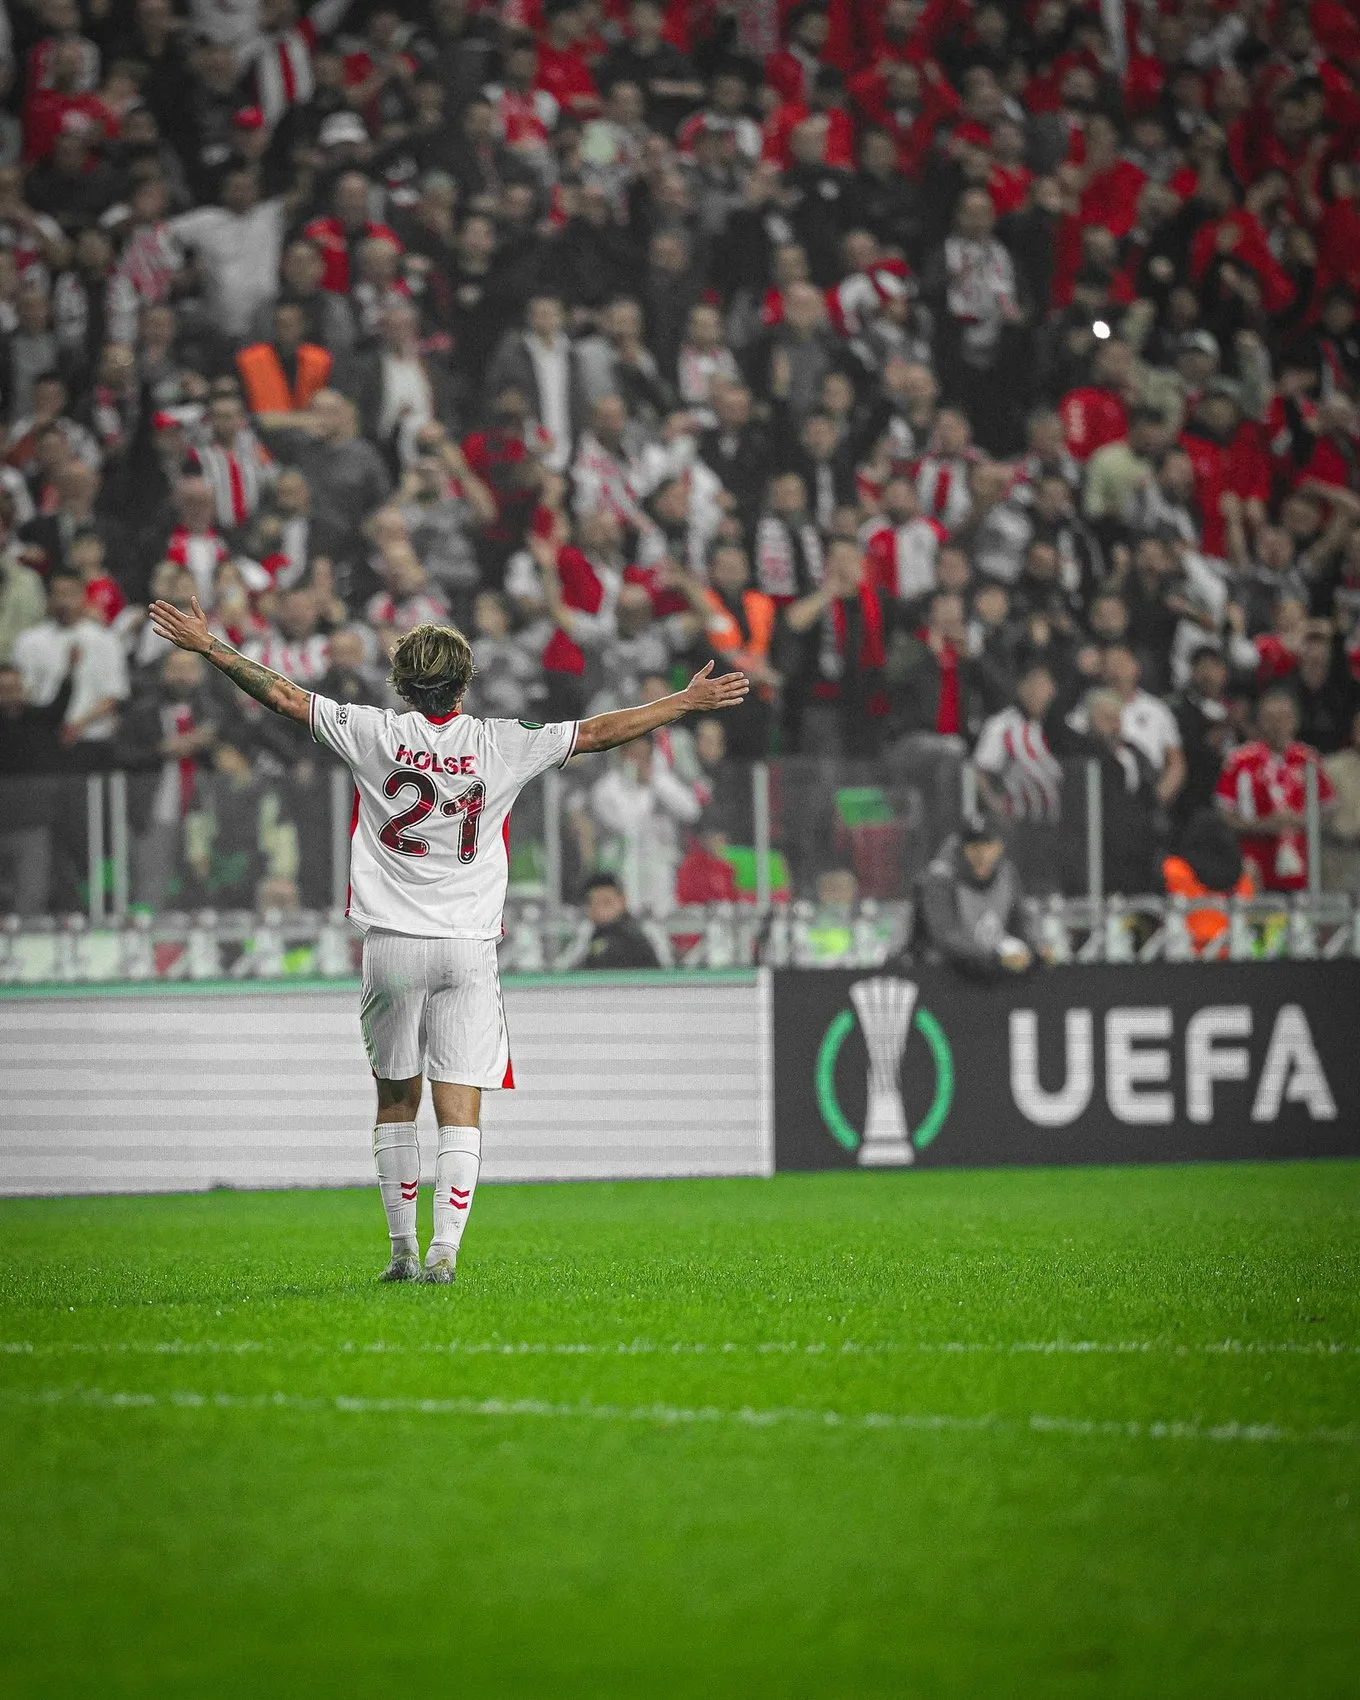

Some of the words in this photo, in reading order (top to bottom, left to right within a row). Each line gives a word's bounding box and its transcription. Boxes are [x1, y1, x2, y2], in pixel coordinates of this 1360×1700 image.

[395, 744, 476, 775] HOLSE
[378, 768, 486, 864] 21
[1008, 1004, 1337, 1126] UEFA
